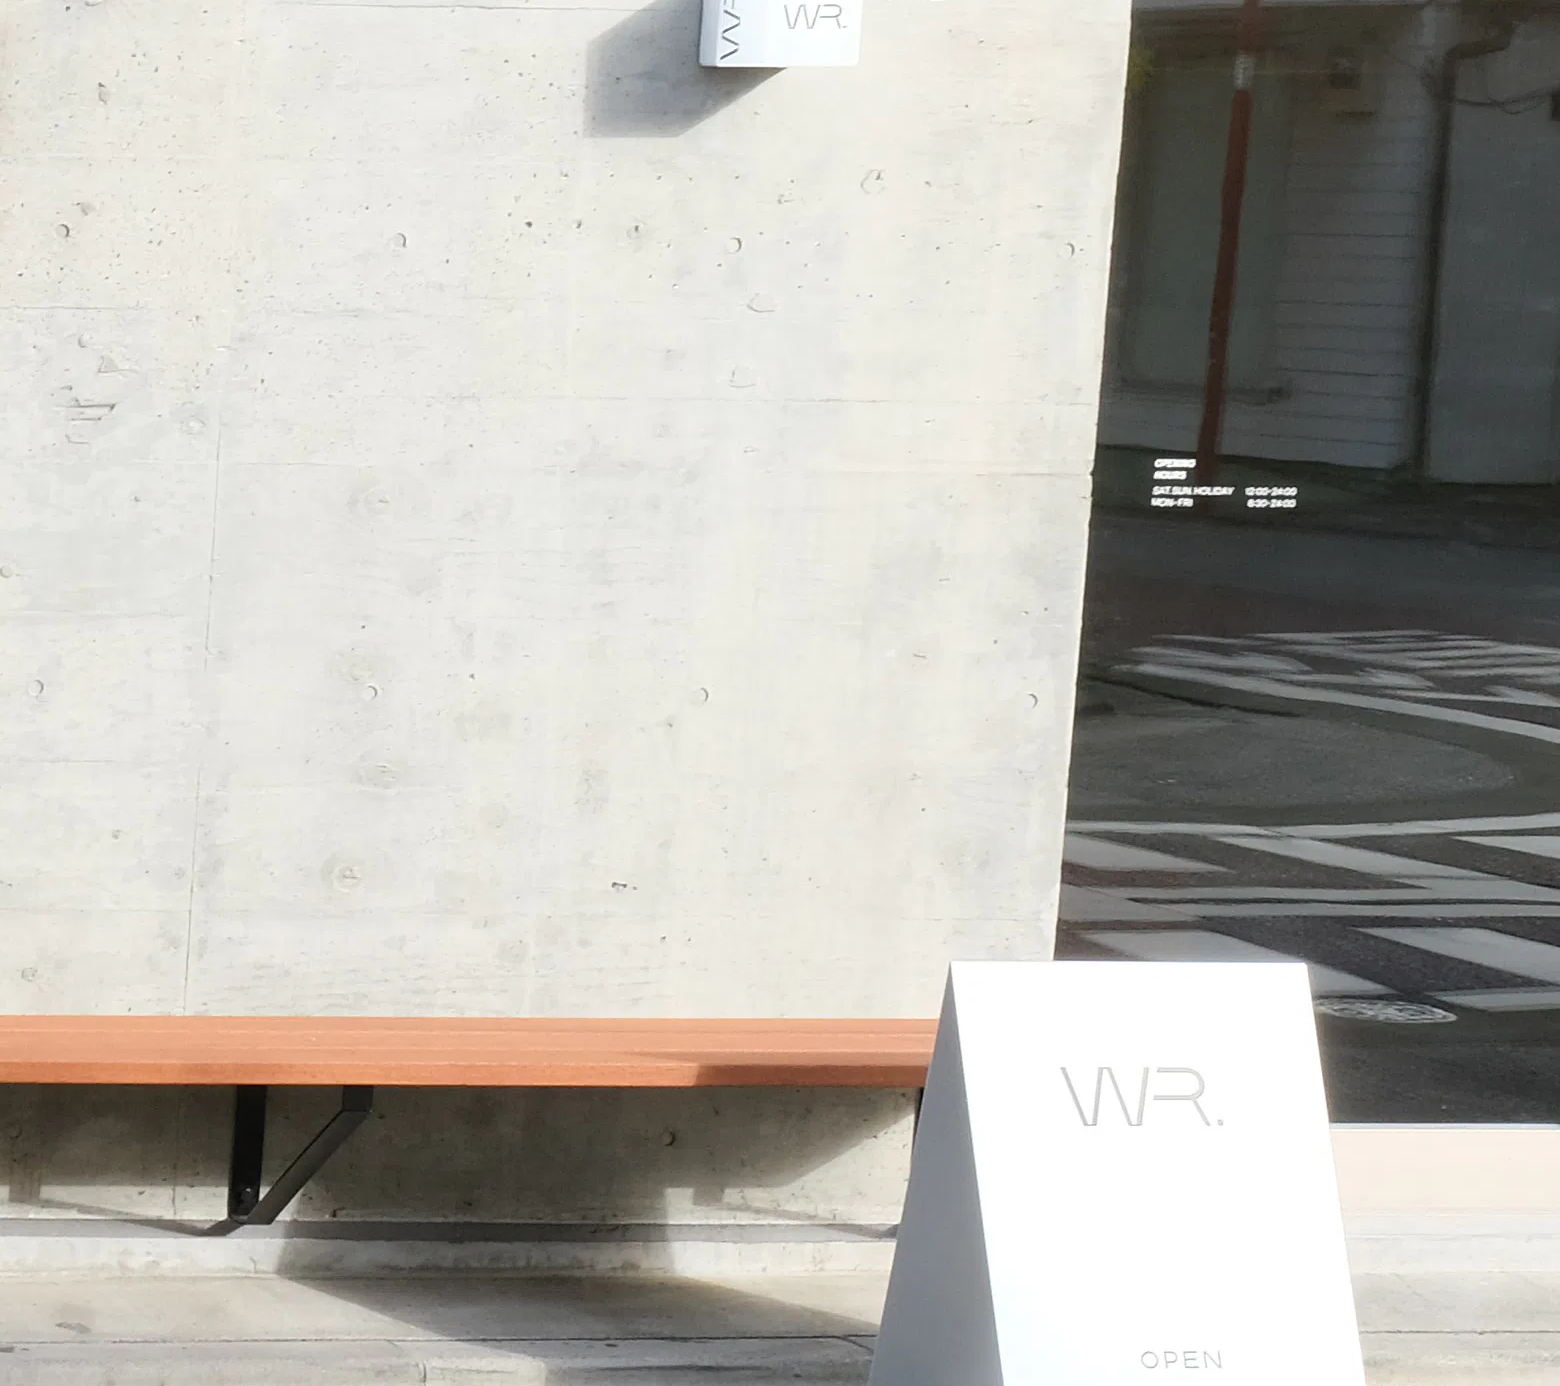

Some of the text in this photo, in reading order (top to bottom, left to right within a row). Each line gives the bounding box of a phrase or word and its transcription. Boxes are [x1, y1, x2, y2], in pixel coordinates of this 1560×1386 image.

[784, 3, 848, 29] WR.
[1060, 1066, 1225, 1127] WR.
[1140, 1350, 1223, 1369] OPEN
